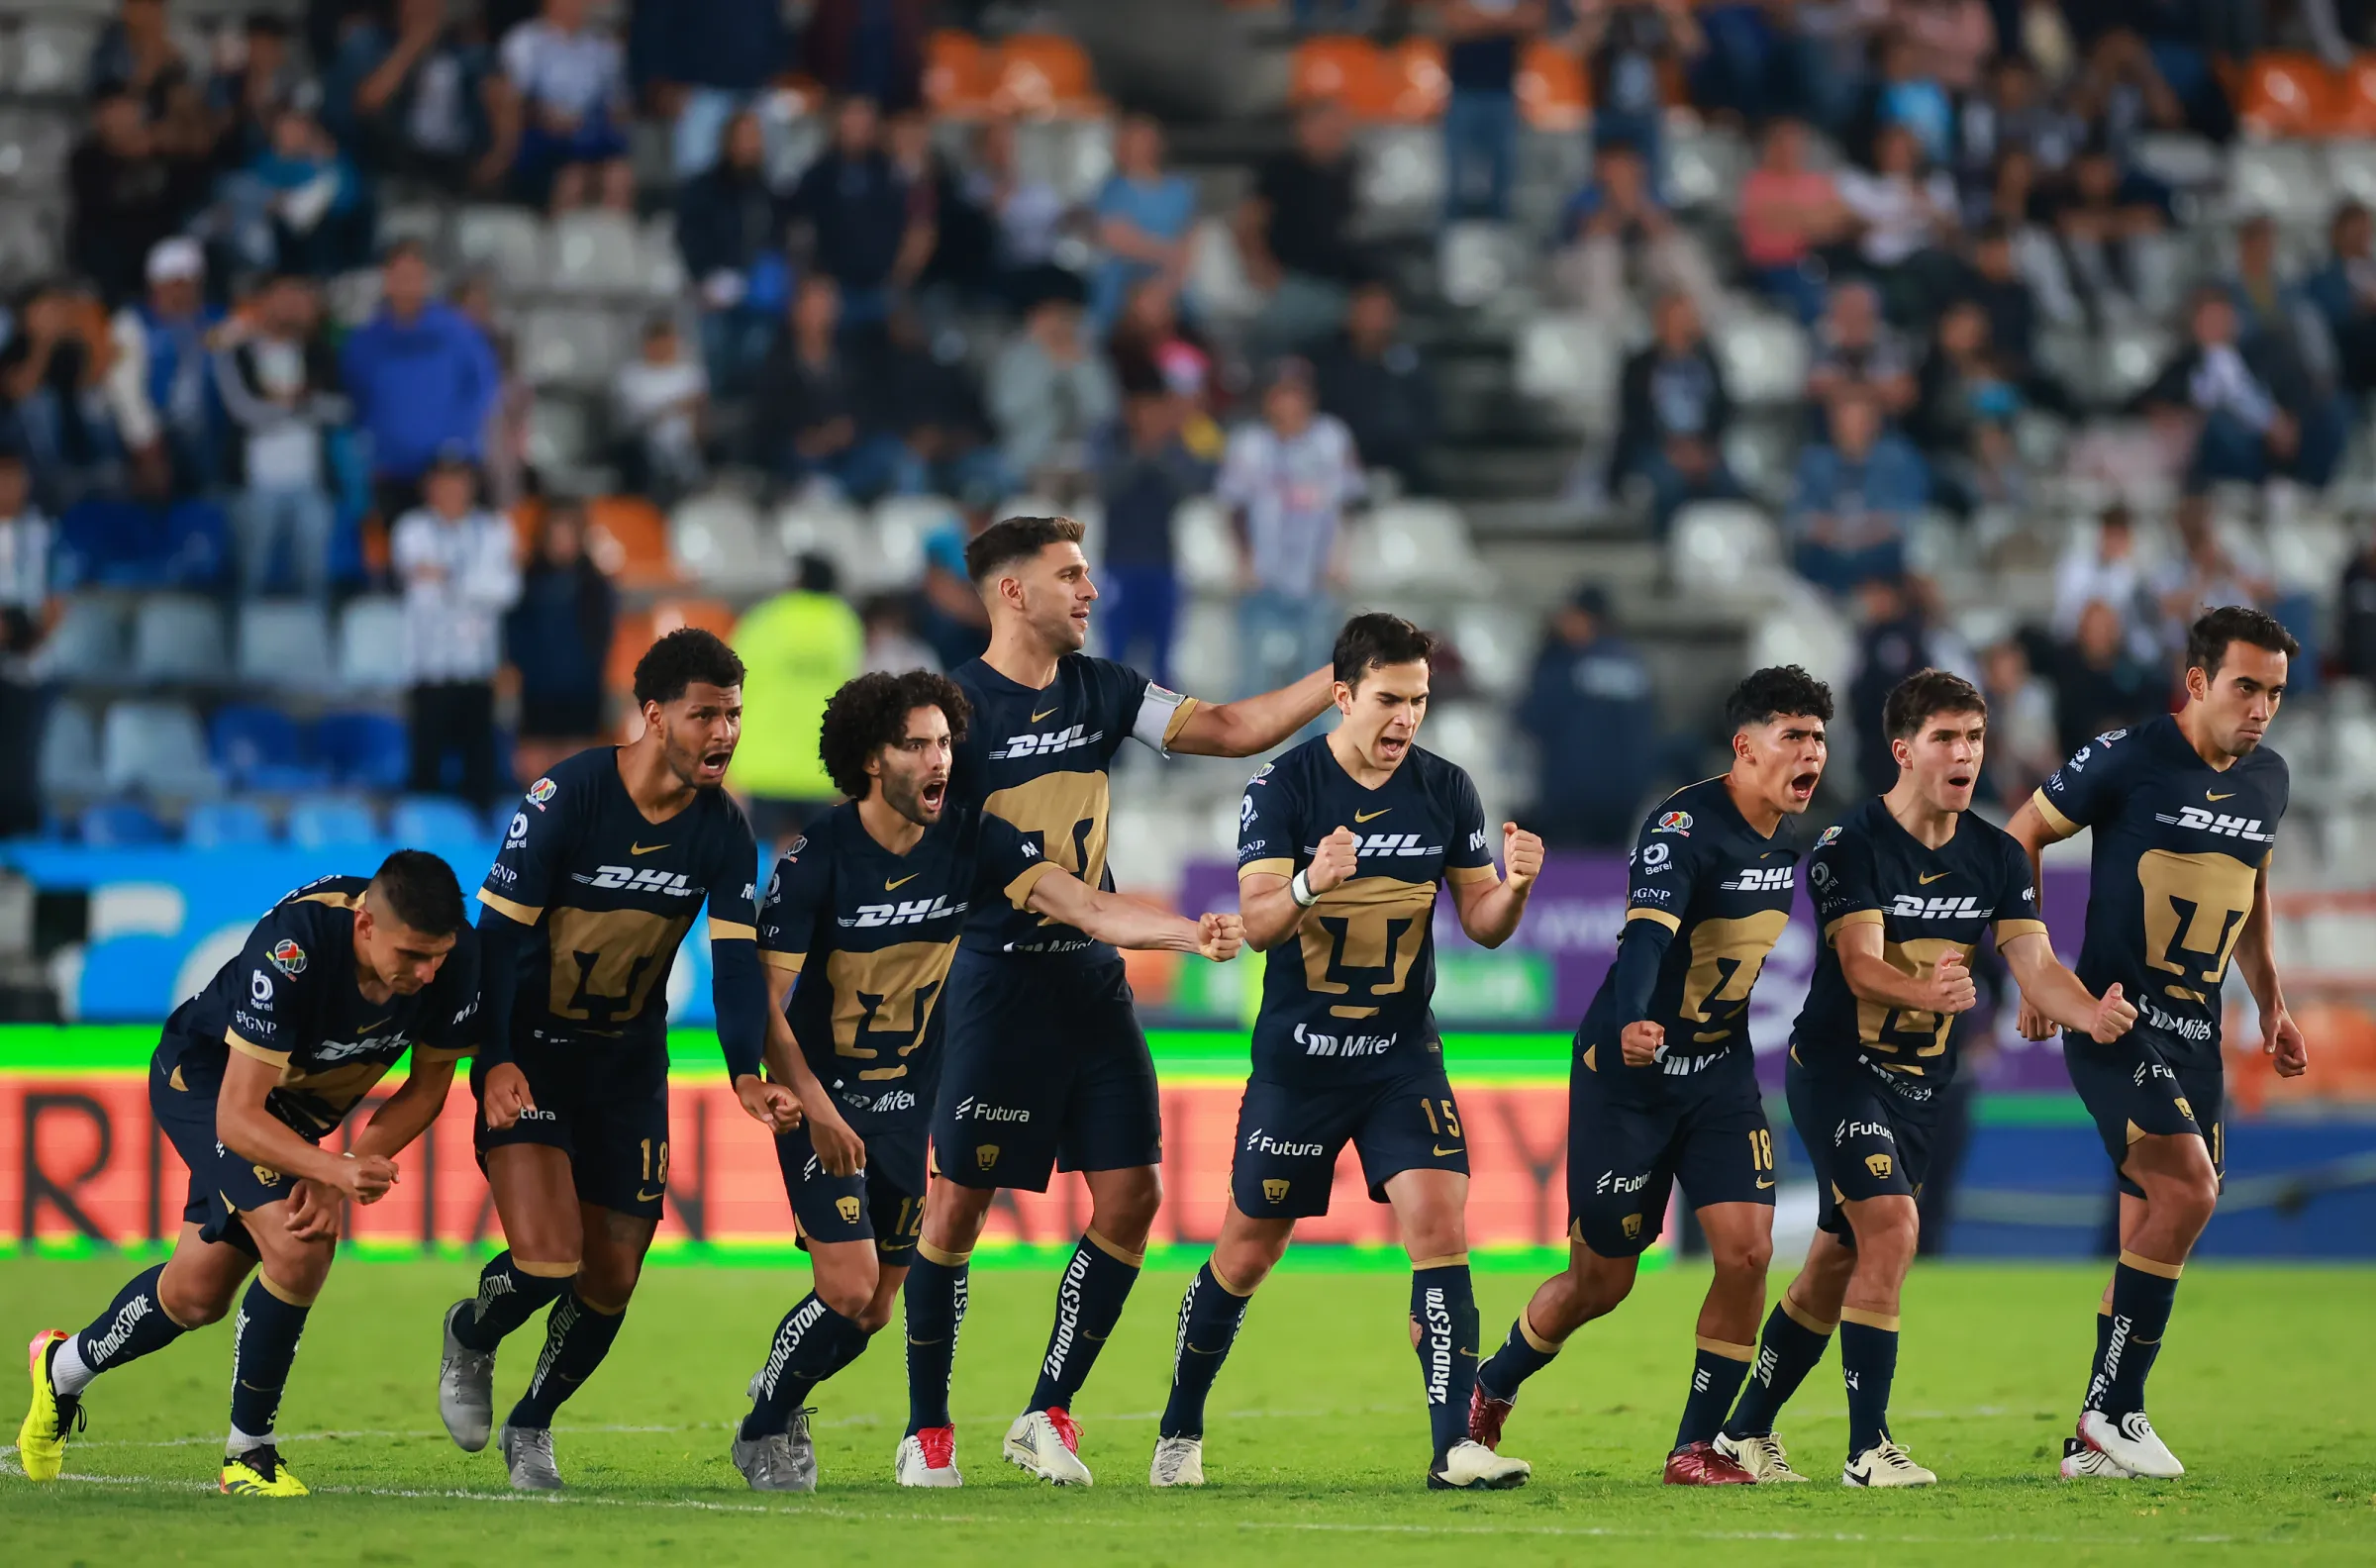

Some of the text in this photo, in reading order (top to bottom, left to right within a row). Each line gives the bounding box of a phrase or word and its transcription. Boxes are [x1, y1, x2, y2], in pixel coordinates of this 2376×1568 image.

[1006, 724, 1089, 758] DHL
[2177, 806, 2267, 841] DHL
[505, 837, 528, 850] Berel
[1352, 833, 1427, 857] HL
[591, 865, 692, 897] DHL
[1644, 861, 1673, 876] Berel
[1737, 866, 1795, 891] DHL
[1636, 887, 1671, 900] GNP
[854, 895, 956, 928] DHL
[1892, 895, 1980, 920] DHL
[246, 1016, 277, 1034] GNP
[520, 1107, 556, 1122] tura
[973, 1103, 1031, 1123] Futura
[1421, 1098, 1460, 1138] 15
[1259, 1136, 1324, 1157] Futura
[1748, 1128, 1773, 1172] 18
[641, 1138, 669, 1185] 18
[895, 1195, 928, 1237] 12
[87, 1293, 153, 1366] BRIDGESTONE
